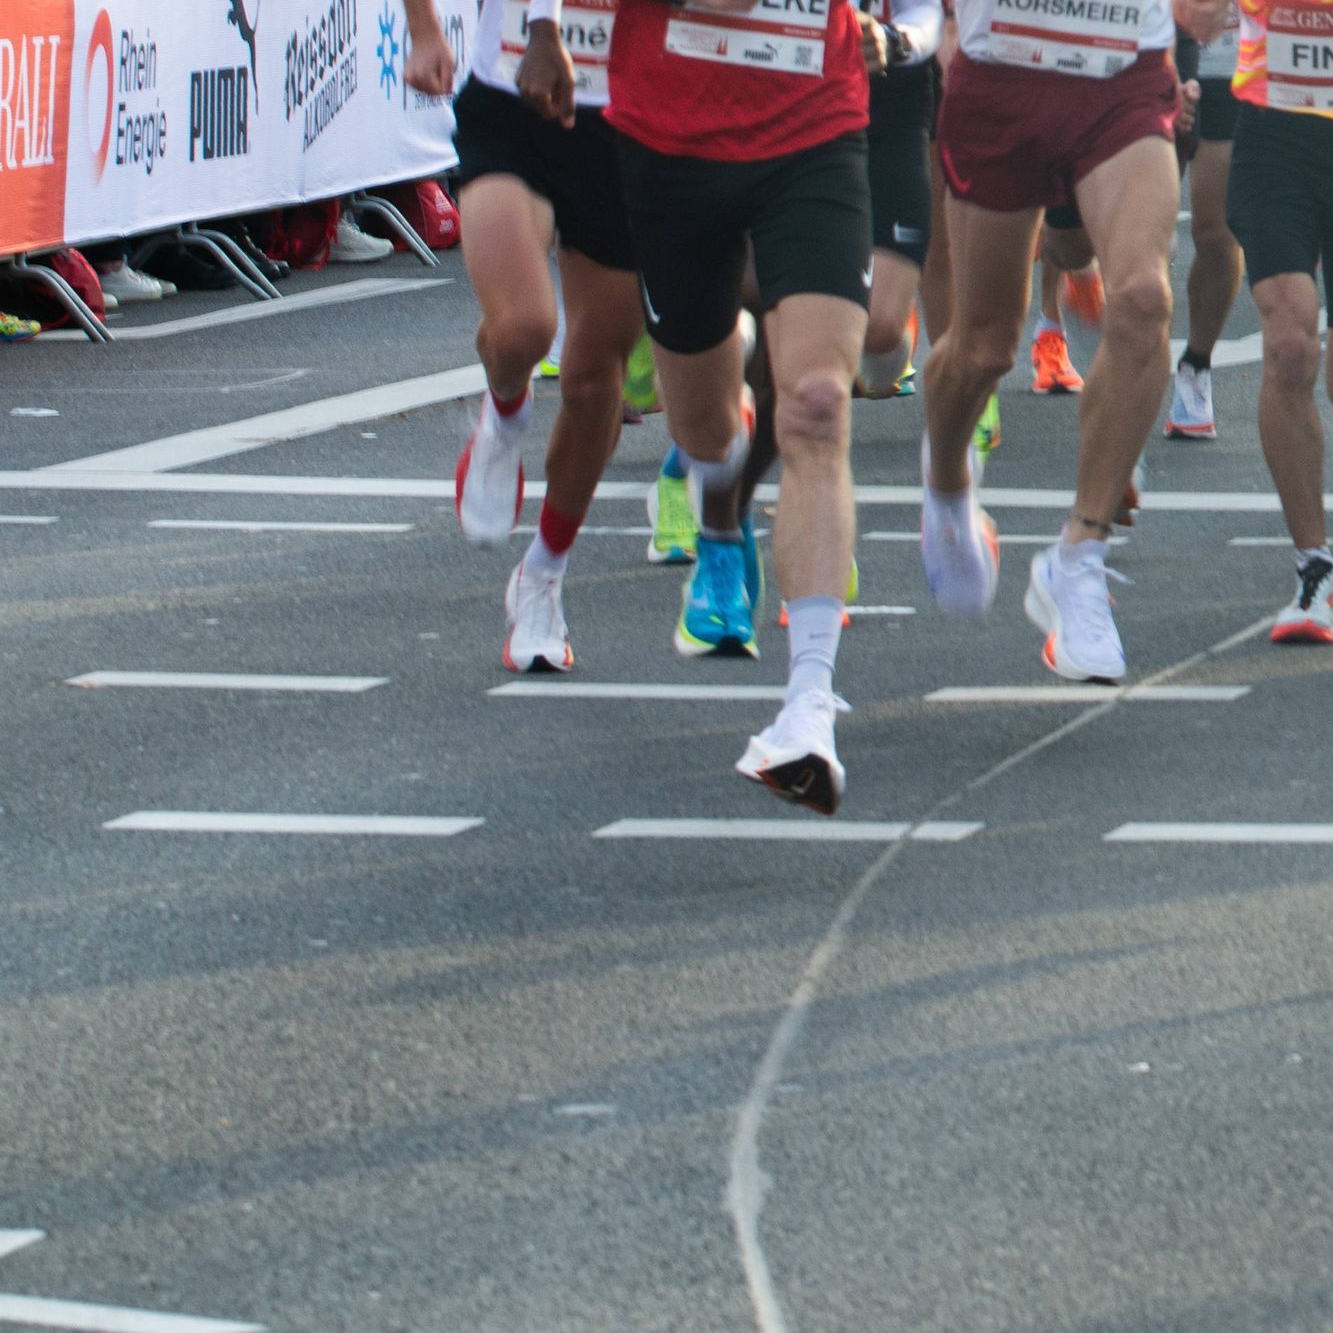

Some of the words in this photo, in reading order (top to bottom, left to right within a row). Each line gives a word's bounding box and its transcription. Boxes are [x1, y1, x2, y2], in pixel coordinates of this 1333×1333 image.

[119, 27, 157, 93] Rhein
[116, 96, 167, 177] Energie
[190, 66, 248, 163] PUMA
